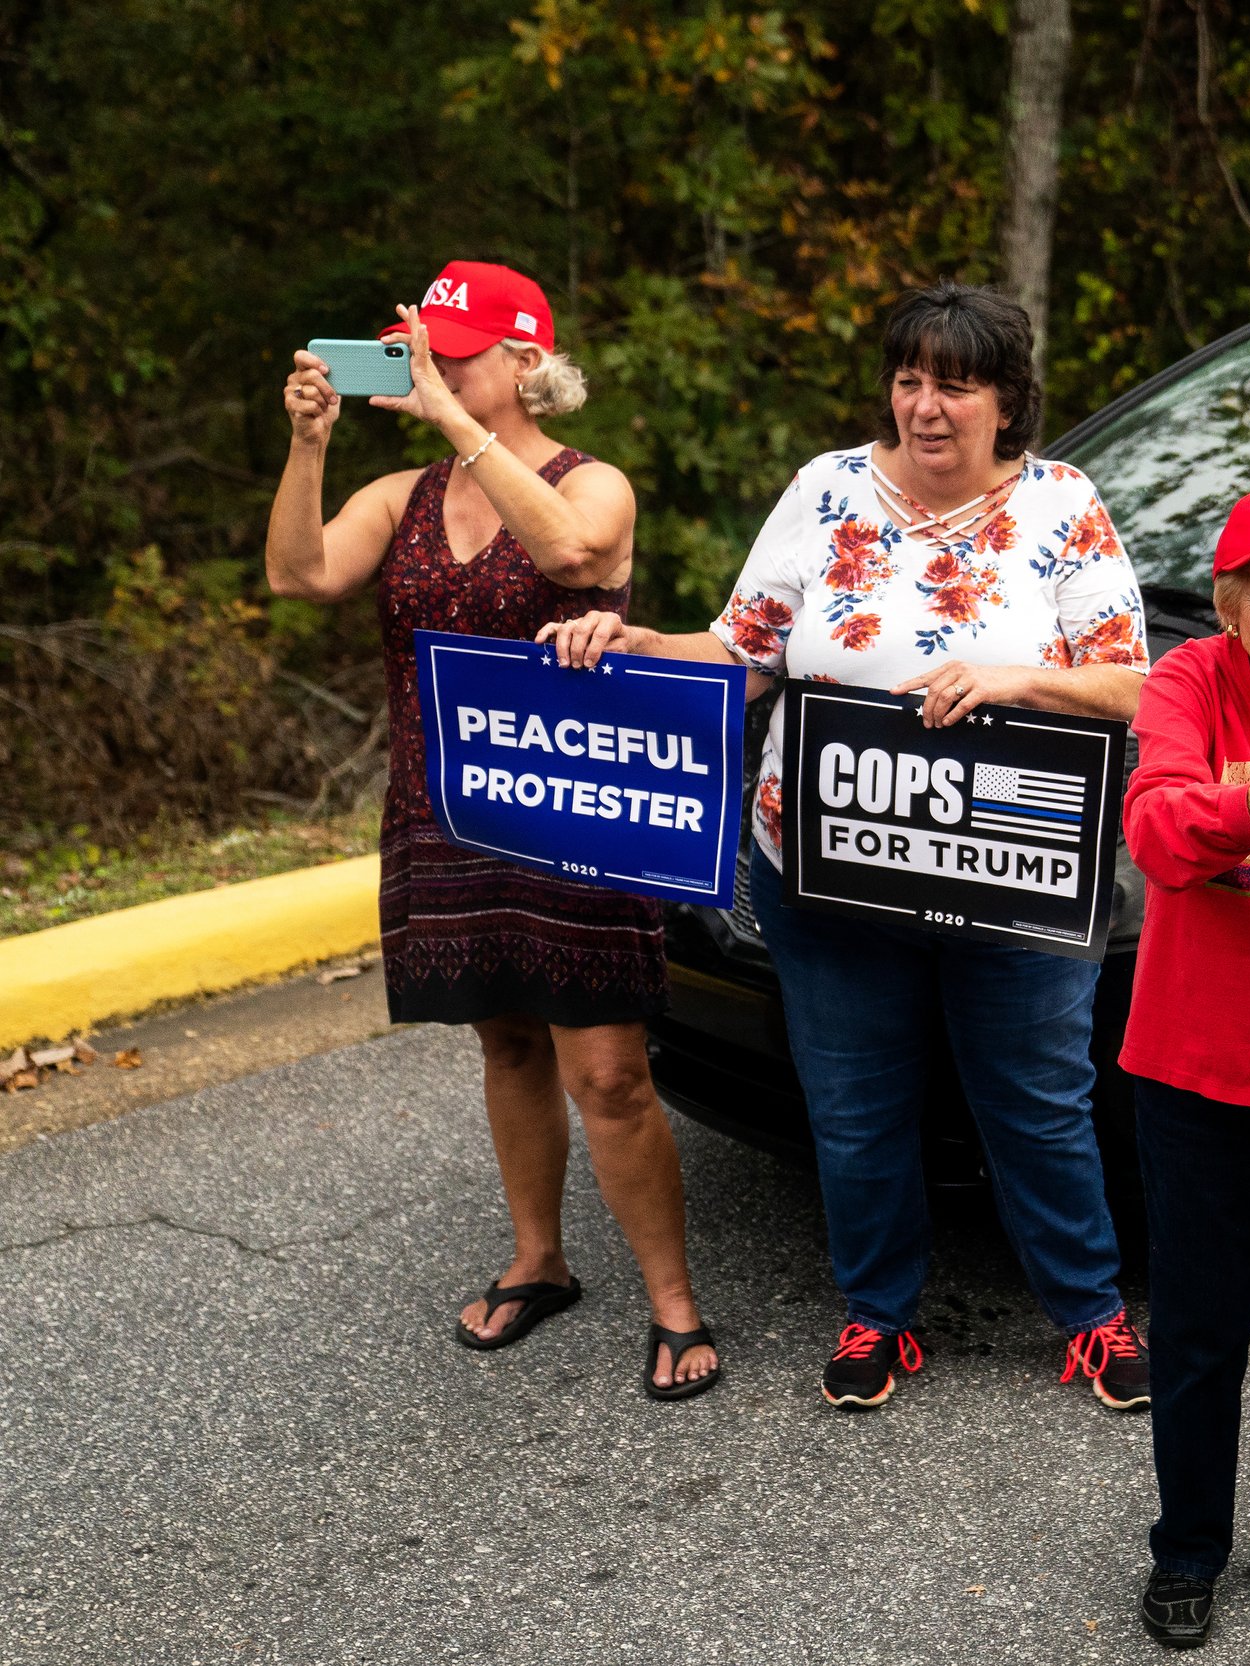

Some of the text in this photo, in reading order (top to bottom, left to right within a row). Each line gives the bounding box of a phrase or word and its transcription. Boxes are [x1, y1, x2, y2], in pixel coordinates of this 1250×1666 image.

[420, 278, 469, 311] USA
[456, 705, 709, 775] PEACEFUL
[461, 764, 704, 832] PROTESTER
[818, 742, 965, 825] COPS
[562, 861, 598, 877] 2020
[829, 824, 1073, 886] FOR TRUMP
[924, 910, 965, 927] 2020
